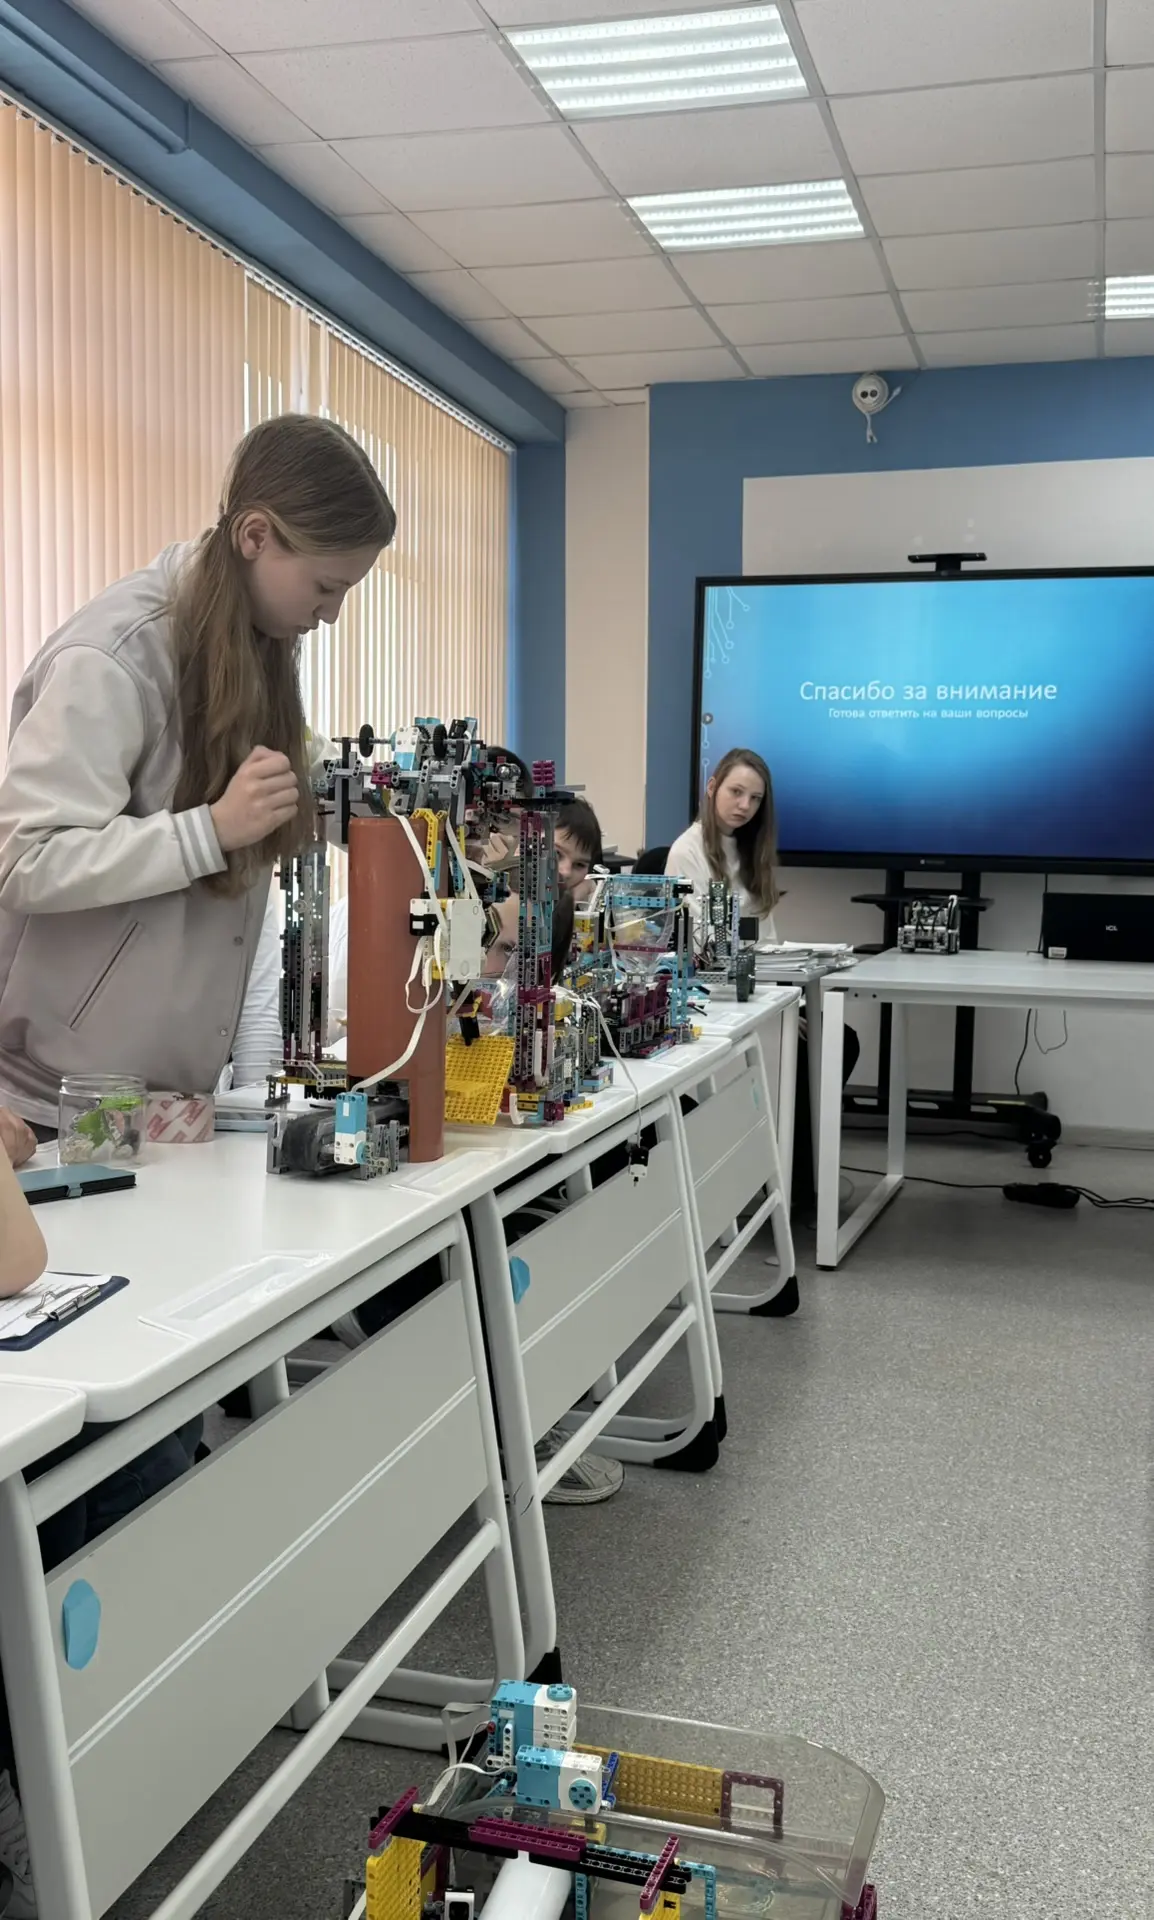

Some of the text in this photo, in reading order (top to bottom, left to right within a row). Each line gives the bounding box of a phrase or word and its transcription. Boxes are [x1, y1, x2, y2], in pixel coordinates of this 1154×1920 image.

[800, 680, 1057, 700] Спасибо за внимание
[828, 708, 1029, 720] Готова ответить на ваши вопросы
